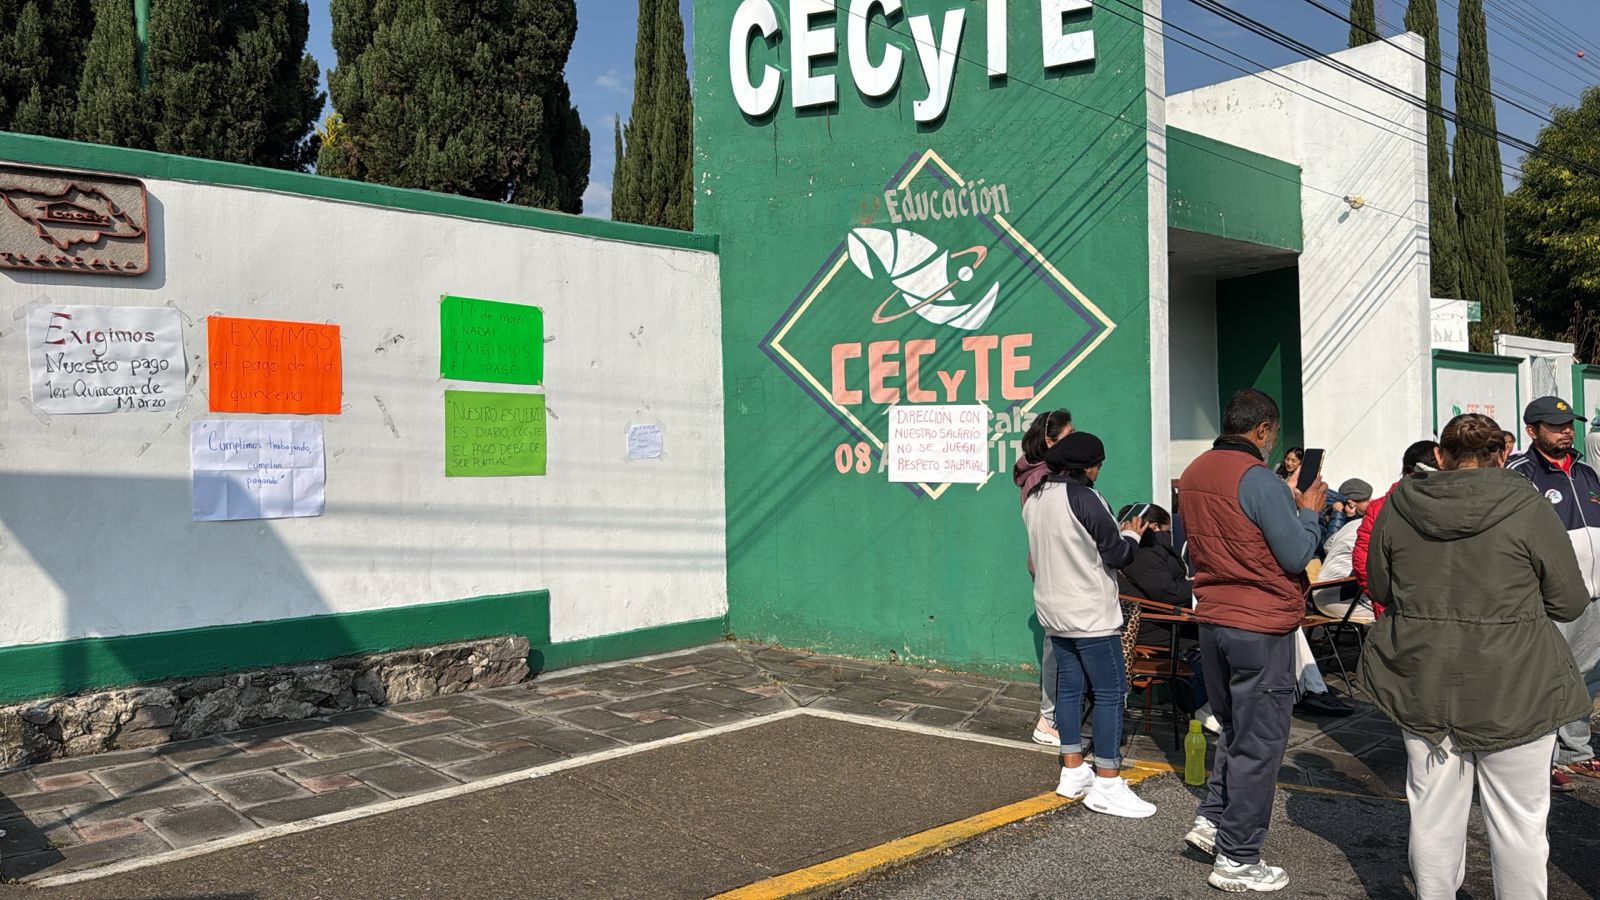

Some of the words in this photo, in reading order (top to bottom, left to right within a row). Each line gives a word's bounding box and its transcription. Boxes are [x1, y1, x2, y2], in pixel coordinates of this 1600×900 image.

[884, 177, 1010, 224] Educación
[43, 312, 156, 357] Exigimos
[230, 322, 333, 352] EXIGIMOS
[454, 340, 530, 361] EXIGIMOS
[45, 352, 118, 374] Nuestro
[131, 358, 169, 376] pago
[213, 352, 228, 373] el
[242, 360, 280, 379] pago
[287, 354, 305, 372] de
[316, 354, 334, 373] la
[45, 380, 69, 399] 1er
[73, 379, 137, 397] Quincena
[141, 377, 164, 394] de
[117, 396, 166, 409] Marzo
[230, 389, 305, 408] quincena
[960, 410, 980, 424] CON
[453, 426, 468, 439] ES
[895, 428, 937, 439] NUESTRO
[940, 427, 981, 439] SALARIO
[452, 445, 467, 457] EL
[471, 442, 496, 457] PAGO
[500, 441, 525, 456] DEBE
[529, 442, 541, 453] DE
[897, 443, 912, 454] NO
[919, 443, 935, 453] SE
[942, 441, 976, 454] JUEGA
[452, 458, 469, 469] SER
[834, 441, 872, 474] 08
[898, 457, 940, 471] RESPETO
[944, 459, 986, 472] SALARIAL
[247, 460, 283, 474] cumplan
